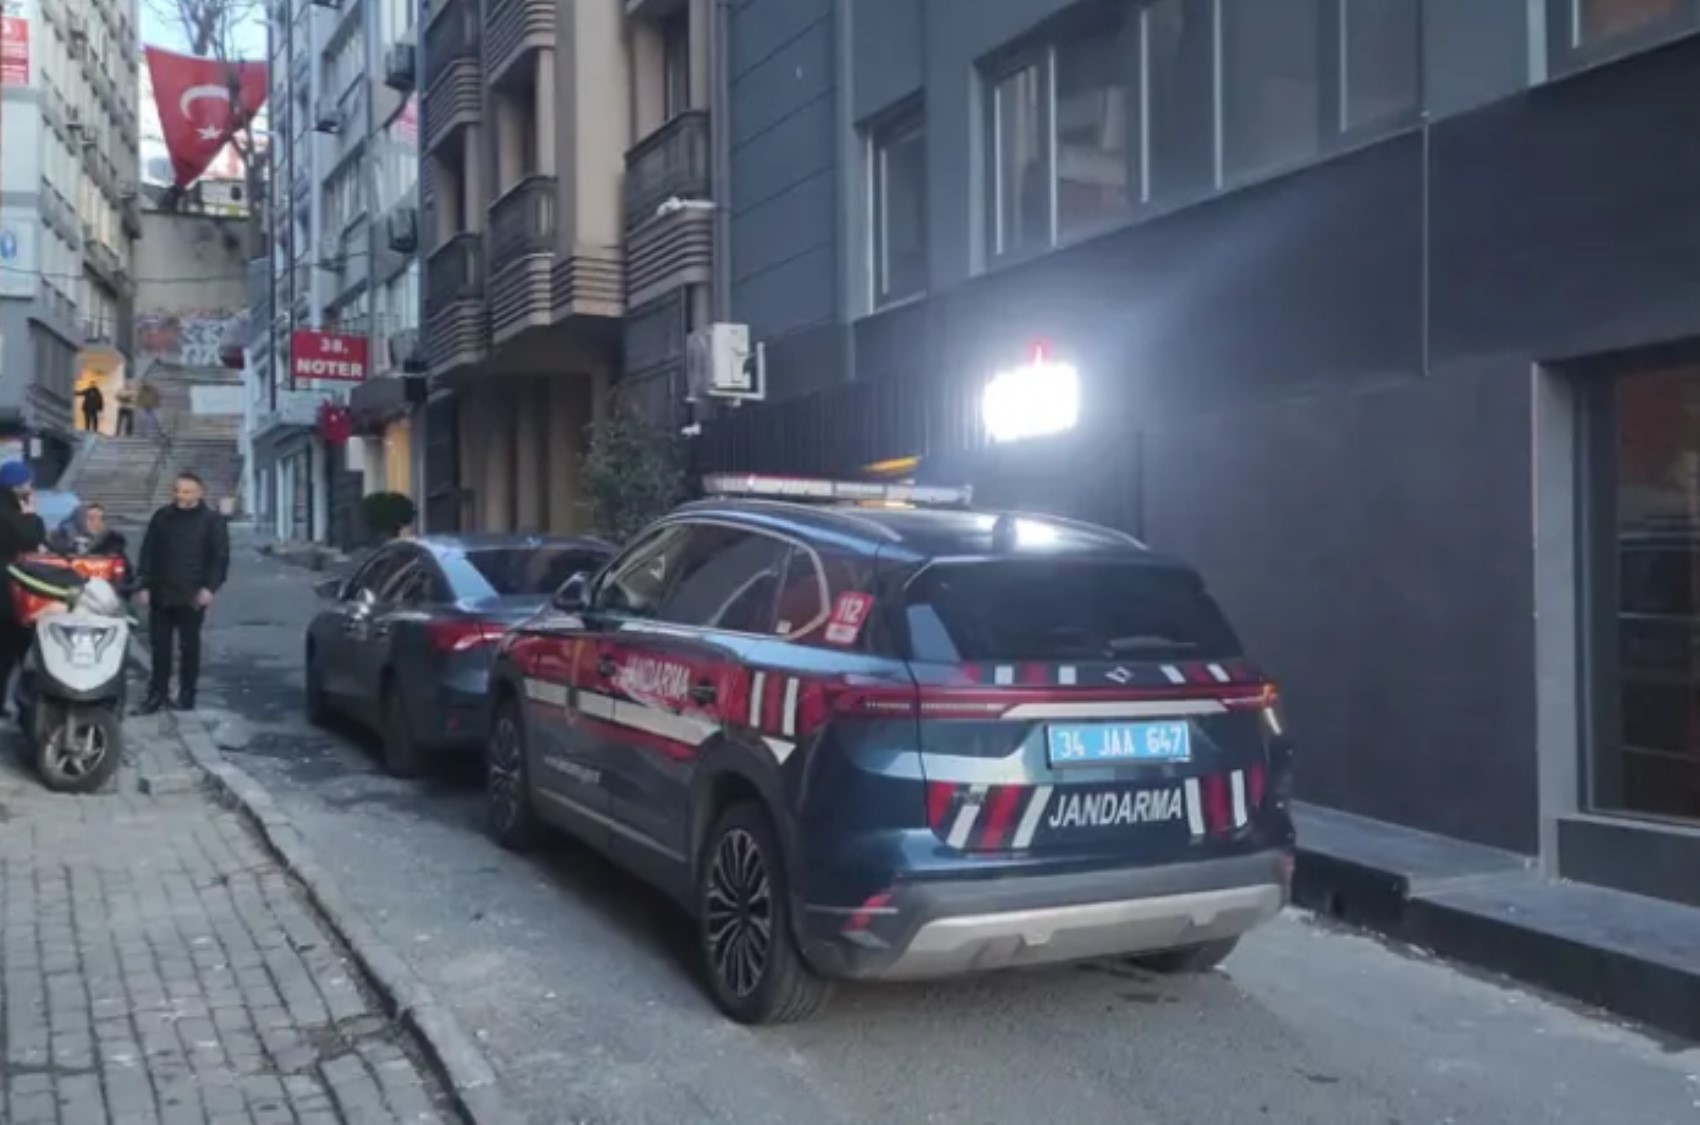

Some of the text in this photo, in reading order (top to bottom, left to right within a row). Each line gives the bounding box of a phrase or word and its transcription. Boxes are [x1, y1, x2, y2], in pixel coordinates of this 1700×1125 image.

[296, 358, 363, 377] NOTER
[838, 597, 865, 623] 112
[1057, 725, 1182, 757] 34 JAA 647
[1048, 787, 1182, 828] JANDARMA
